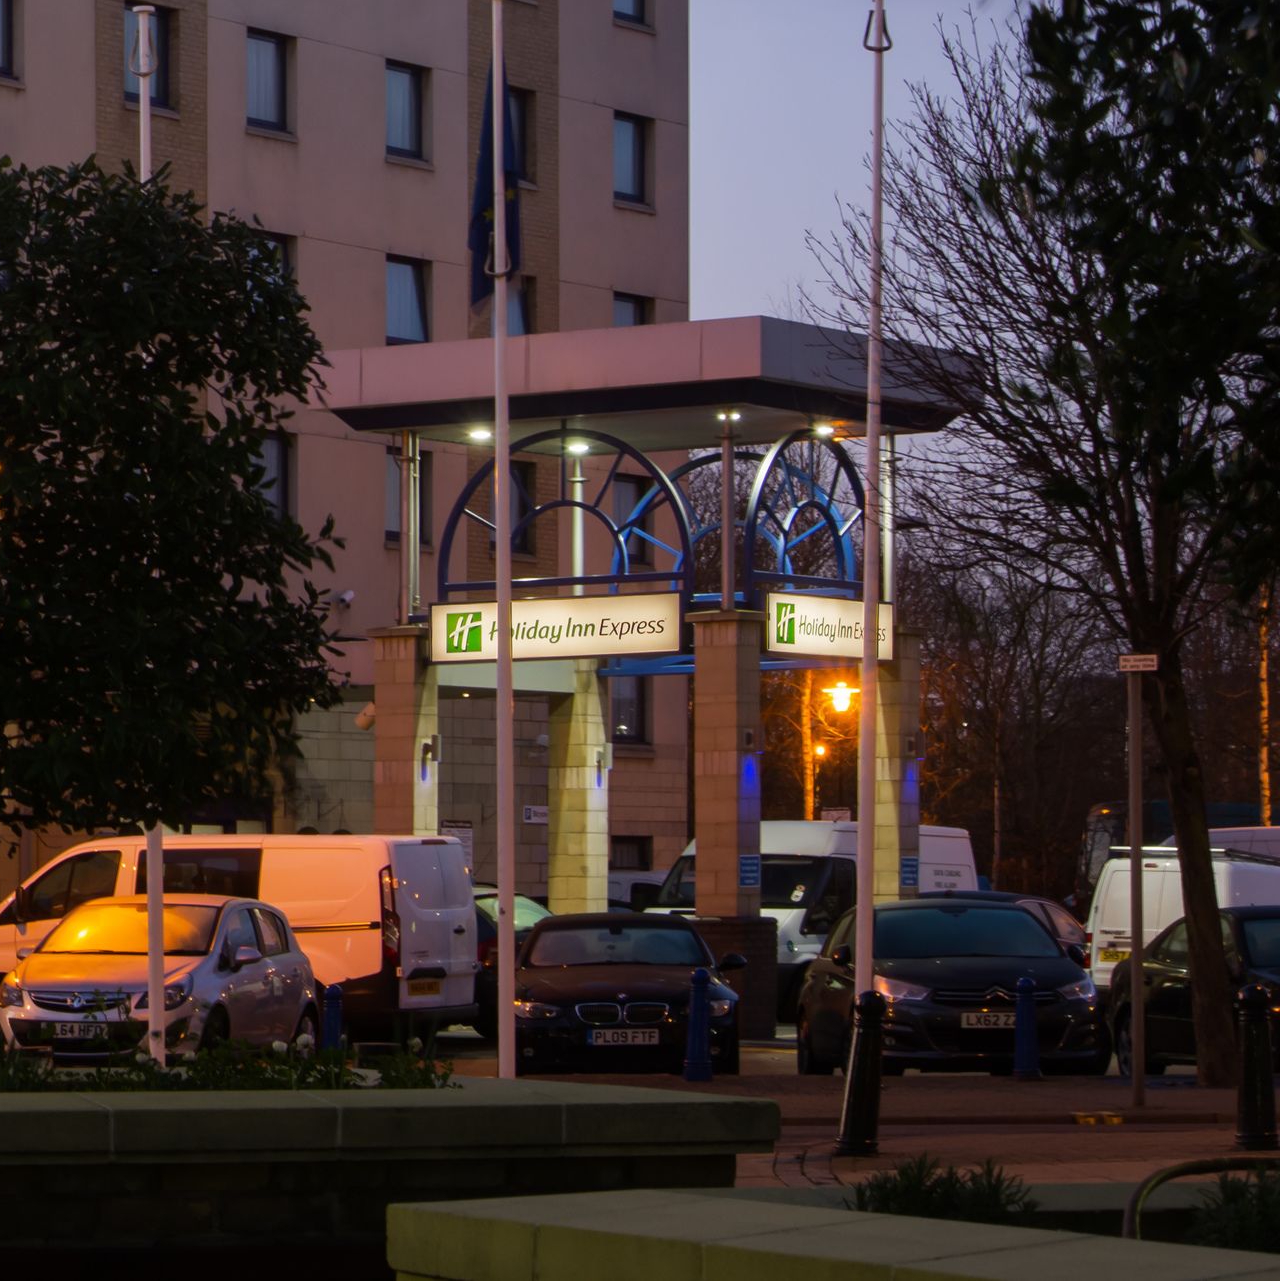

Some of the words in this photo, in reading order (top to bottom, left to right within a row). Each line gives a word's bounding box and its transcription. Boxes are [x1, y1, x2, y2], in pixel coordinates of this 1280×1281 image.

[488, 619, 562, 644] Hliday
[565, 617, 595, 637] Inn
[599, 618, 665, 640] Express
[798, 614, 836, 643] Holiday
[838, 618, 852, 639] Inn
[966, 1014, 1000, 1026] LX62
[594, 1031, 629, 1043] PL09
[631, 1031, 657, 1043] FTF
